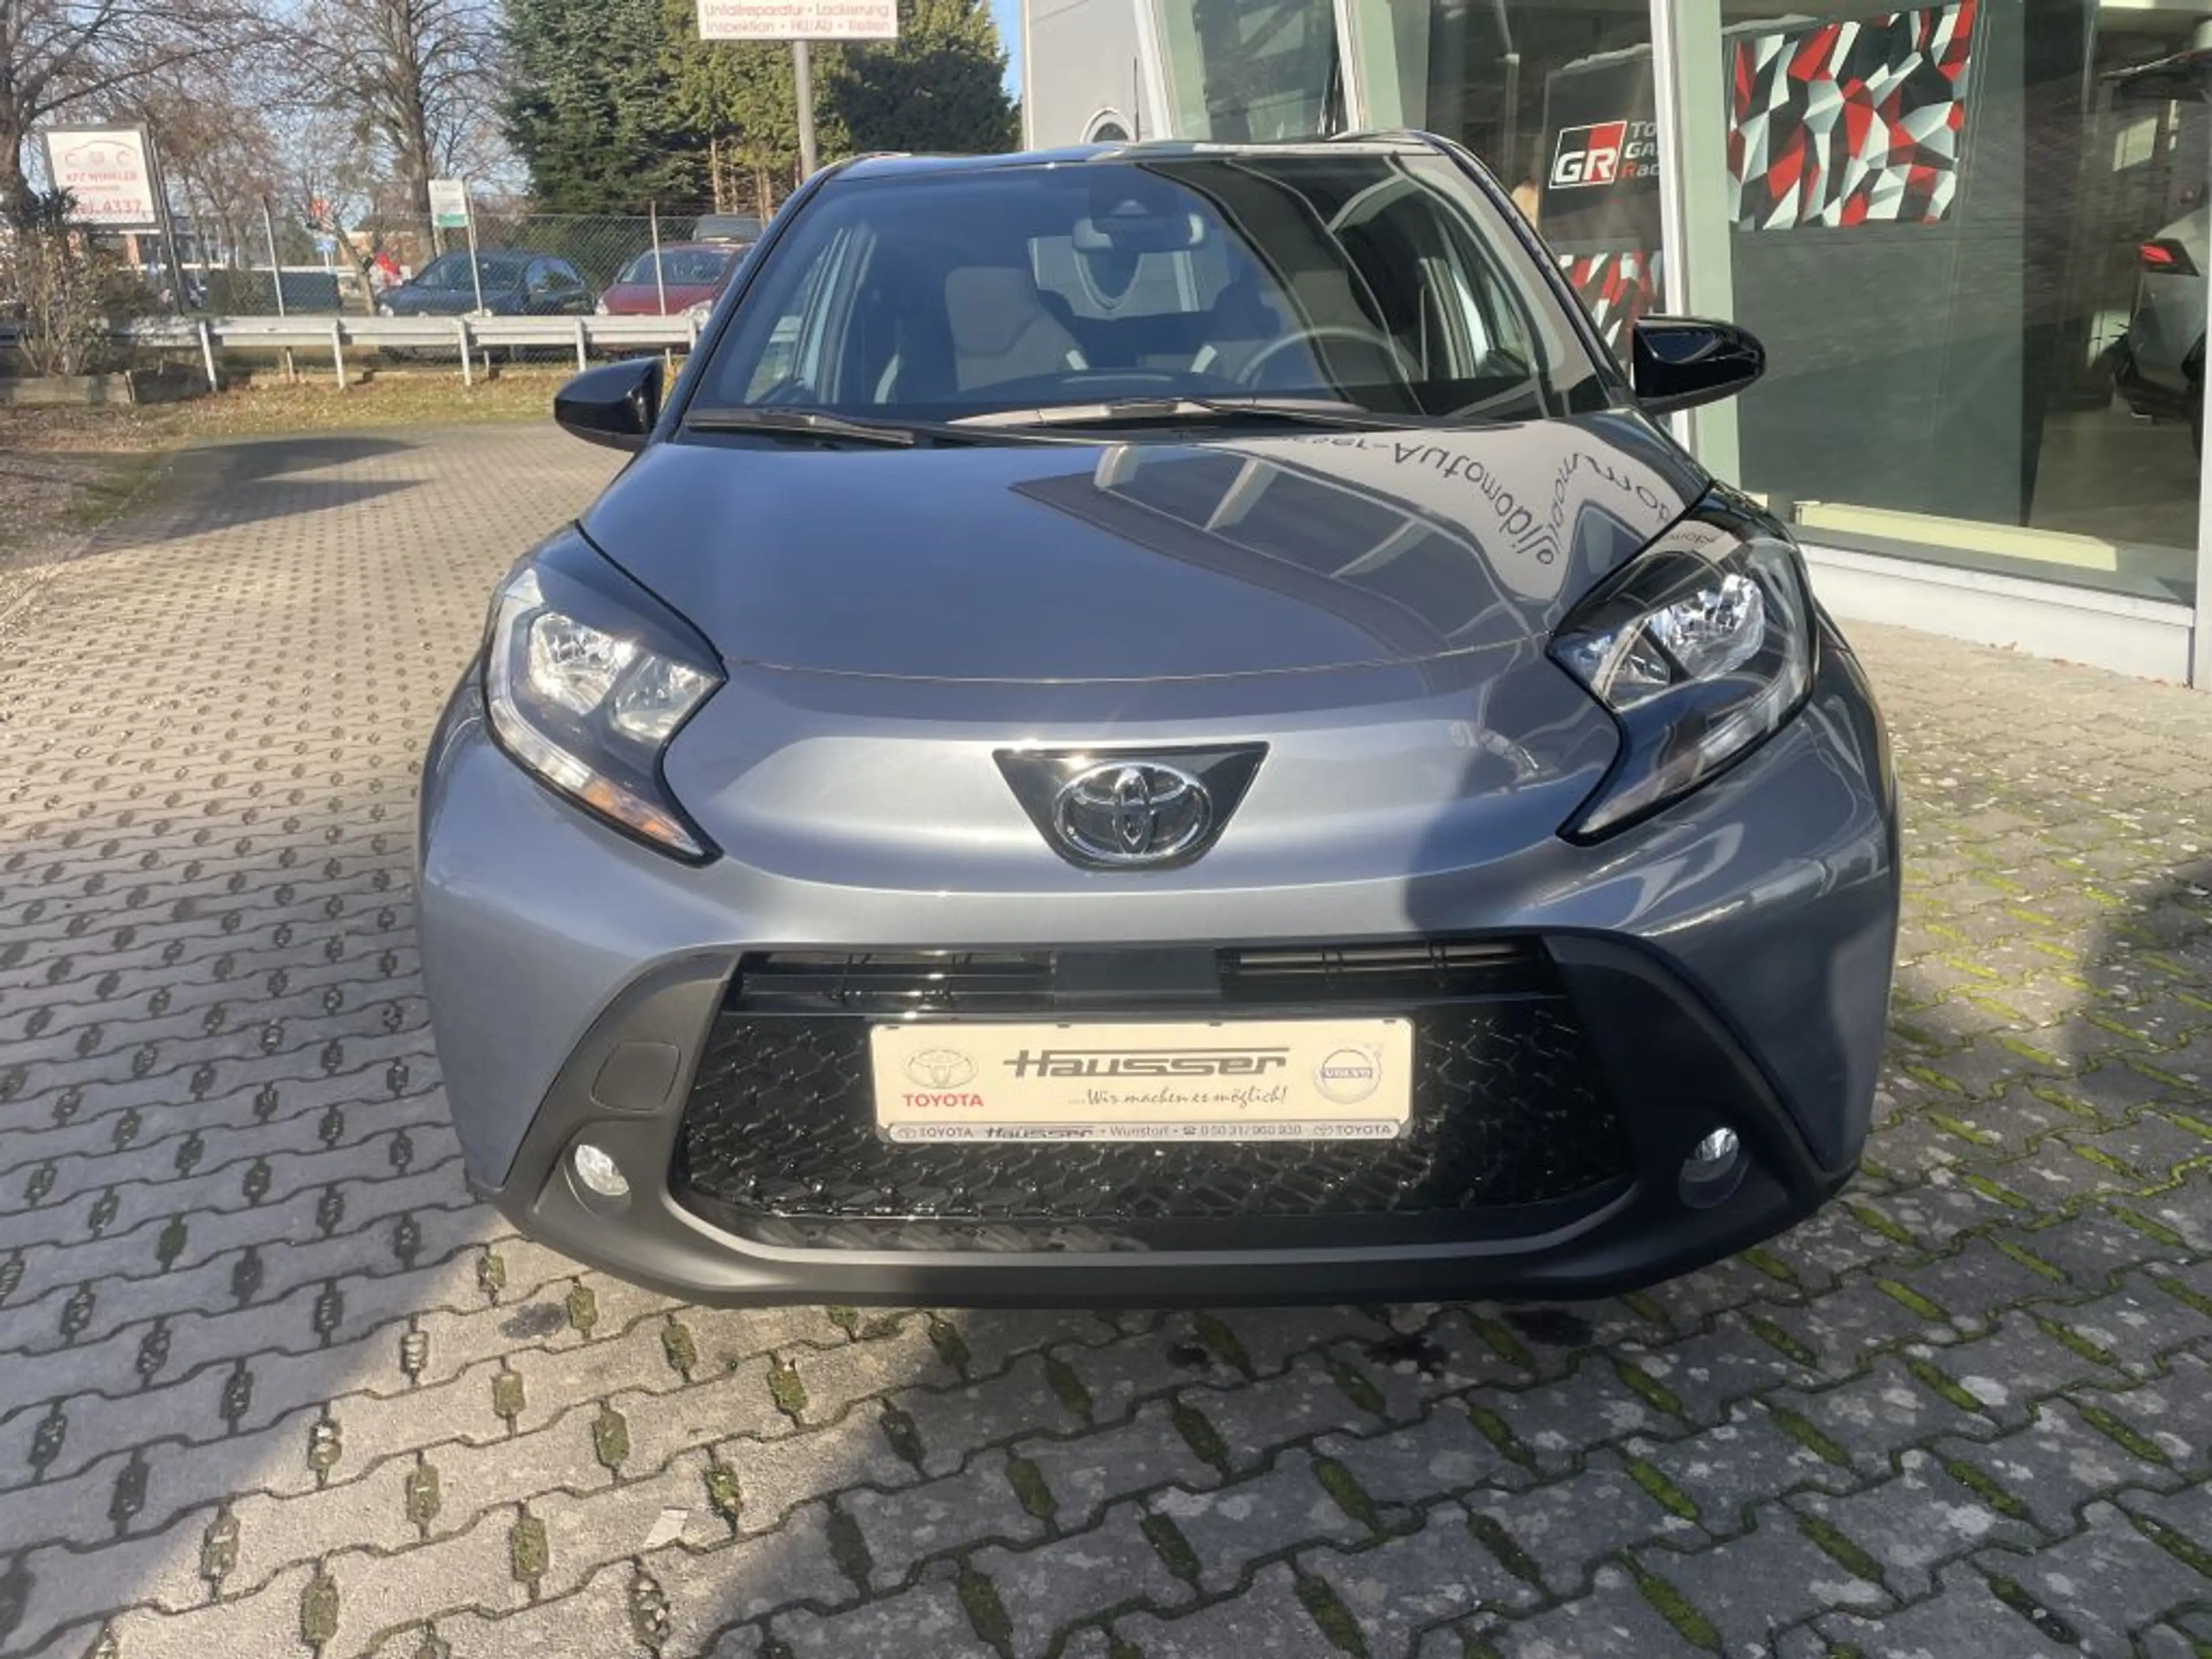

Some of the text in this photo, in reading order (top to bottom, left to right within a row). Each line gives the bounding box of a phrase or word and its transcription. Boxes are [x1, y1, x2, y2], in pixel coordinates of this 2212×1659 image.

[1555, 148, 1617, 182] GR
[1003, 1047, 1290, 1077] Hausser
[902, 1093, 984, 1107] TOYOTA
[1213, 1085, 1288, 1109] möglich!
[920, 1127, 974, 1138] TOYOTA
[1109, 1126, 1168, 1137] Wunstorf
[1336, 1124, 1392, 1136] TOYOTA
